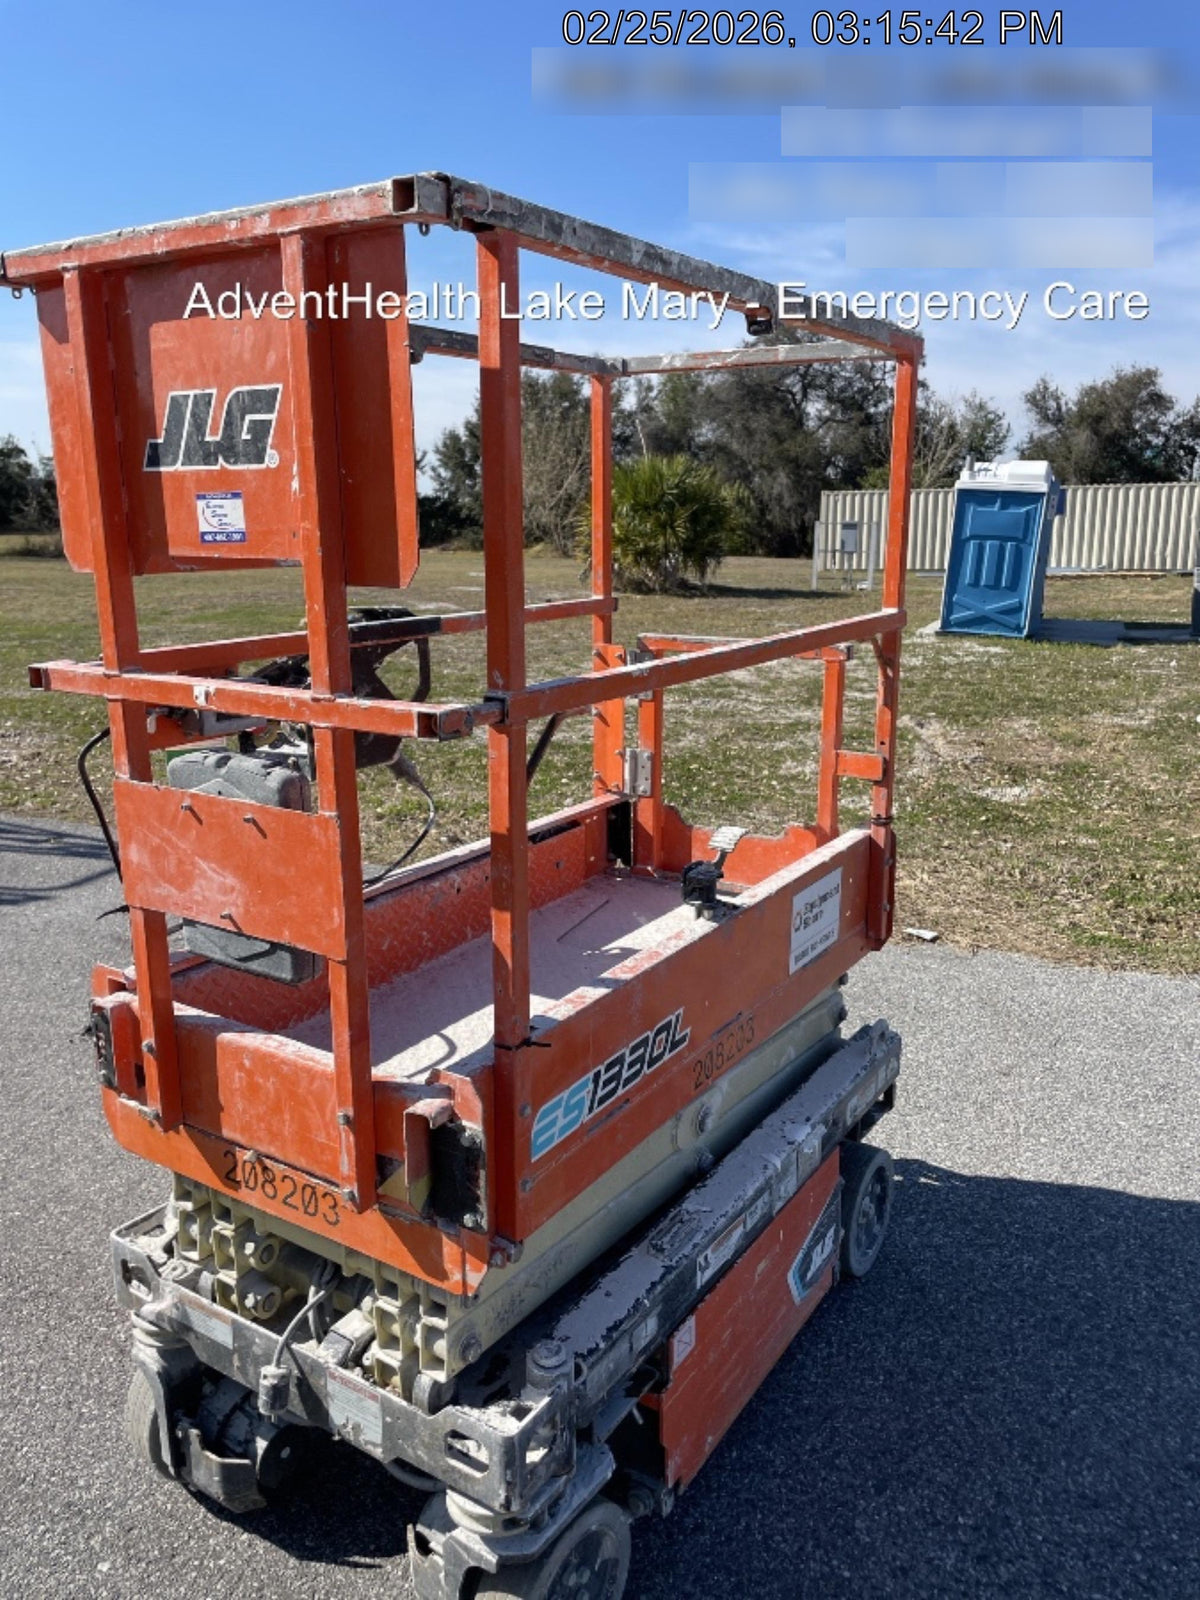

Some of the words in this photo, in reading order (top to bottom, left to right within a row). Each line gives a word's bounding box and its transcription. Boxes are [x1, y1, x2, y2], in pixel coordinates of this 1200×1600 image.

[143, 384, 283, 472] JLG
[531, 1007, 692, 1163] ES1330L
[693, 1015, 755, 1091] 208203
[223, 1150, 341, 1227] 208203
